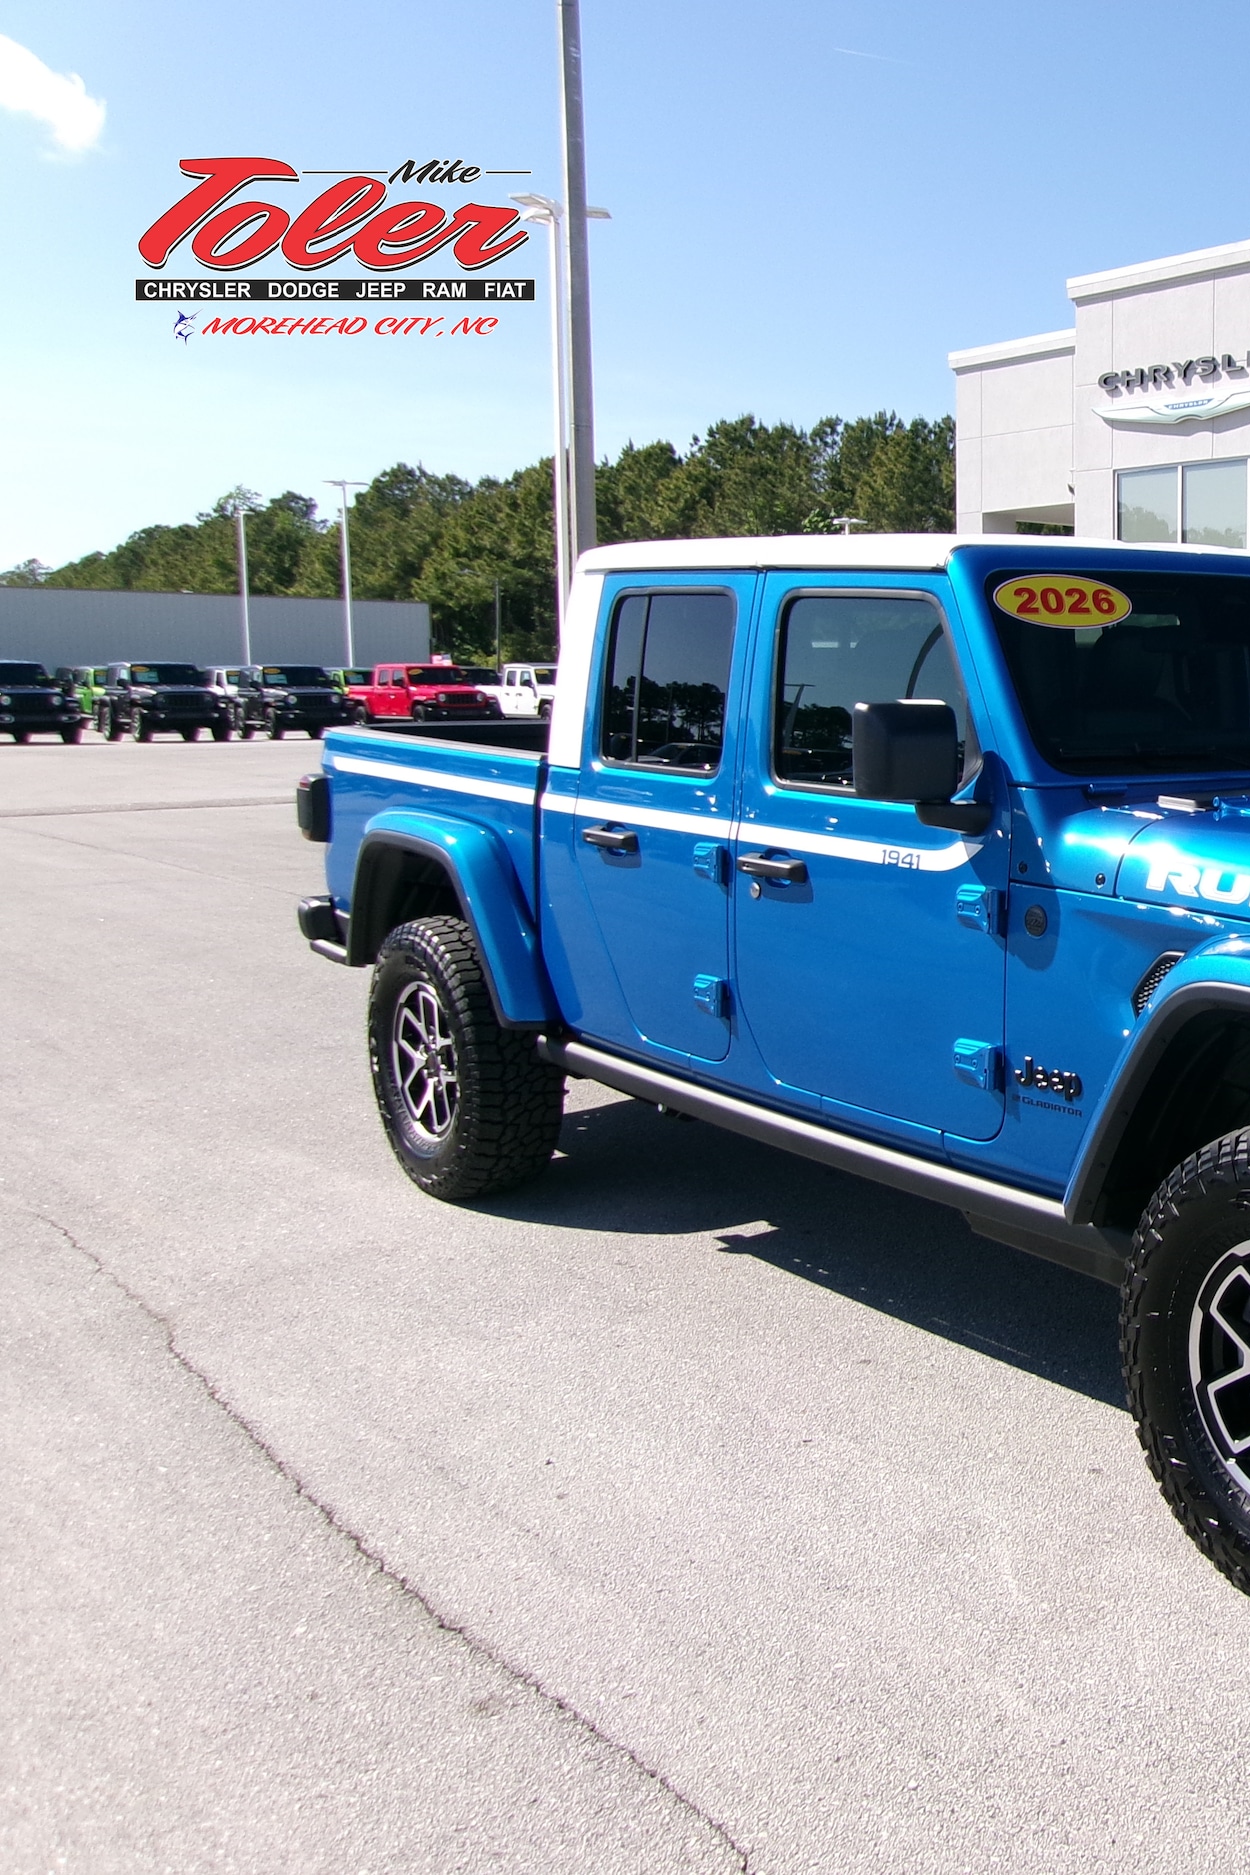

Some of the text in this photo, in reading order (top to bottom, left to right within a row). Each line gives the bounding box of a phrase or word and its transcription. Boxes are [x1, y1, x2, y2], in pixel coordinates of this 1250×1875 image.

[1013, 587, 1117, 616] 2026
[881, 849, 921, 870] 1941
[1014, 1055, 1083, 1102] Jeep
[1021, 1096, 1083, 1118] GLADIATOR
